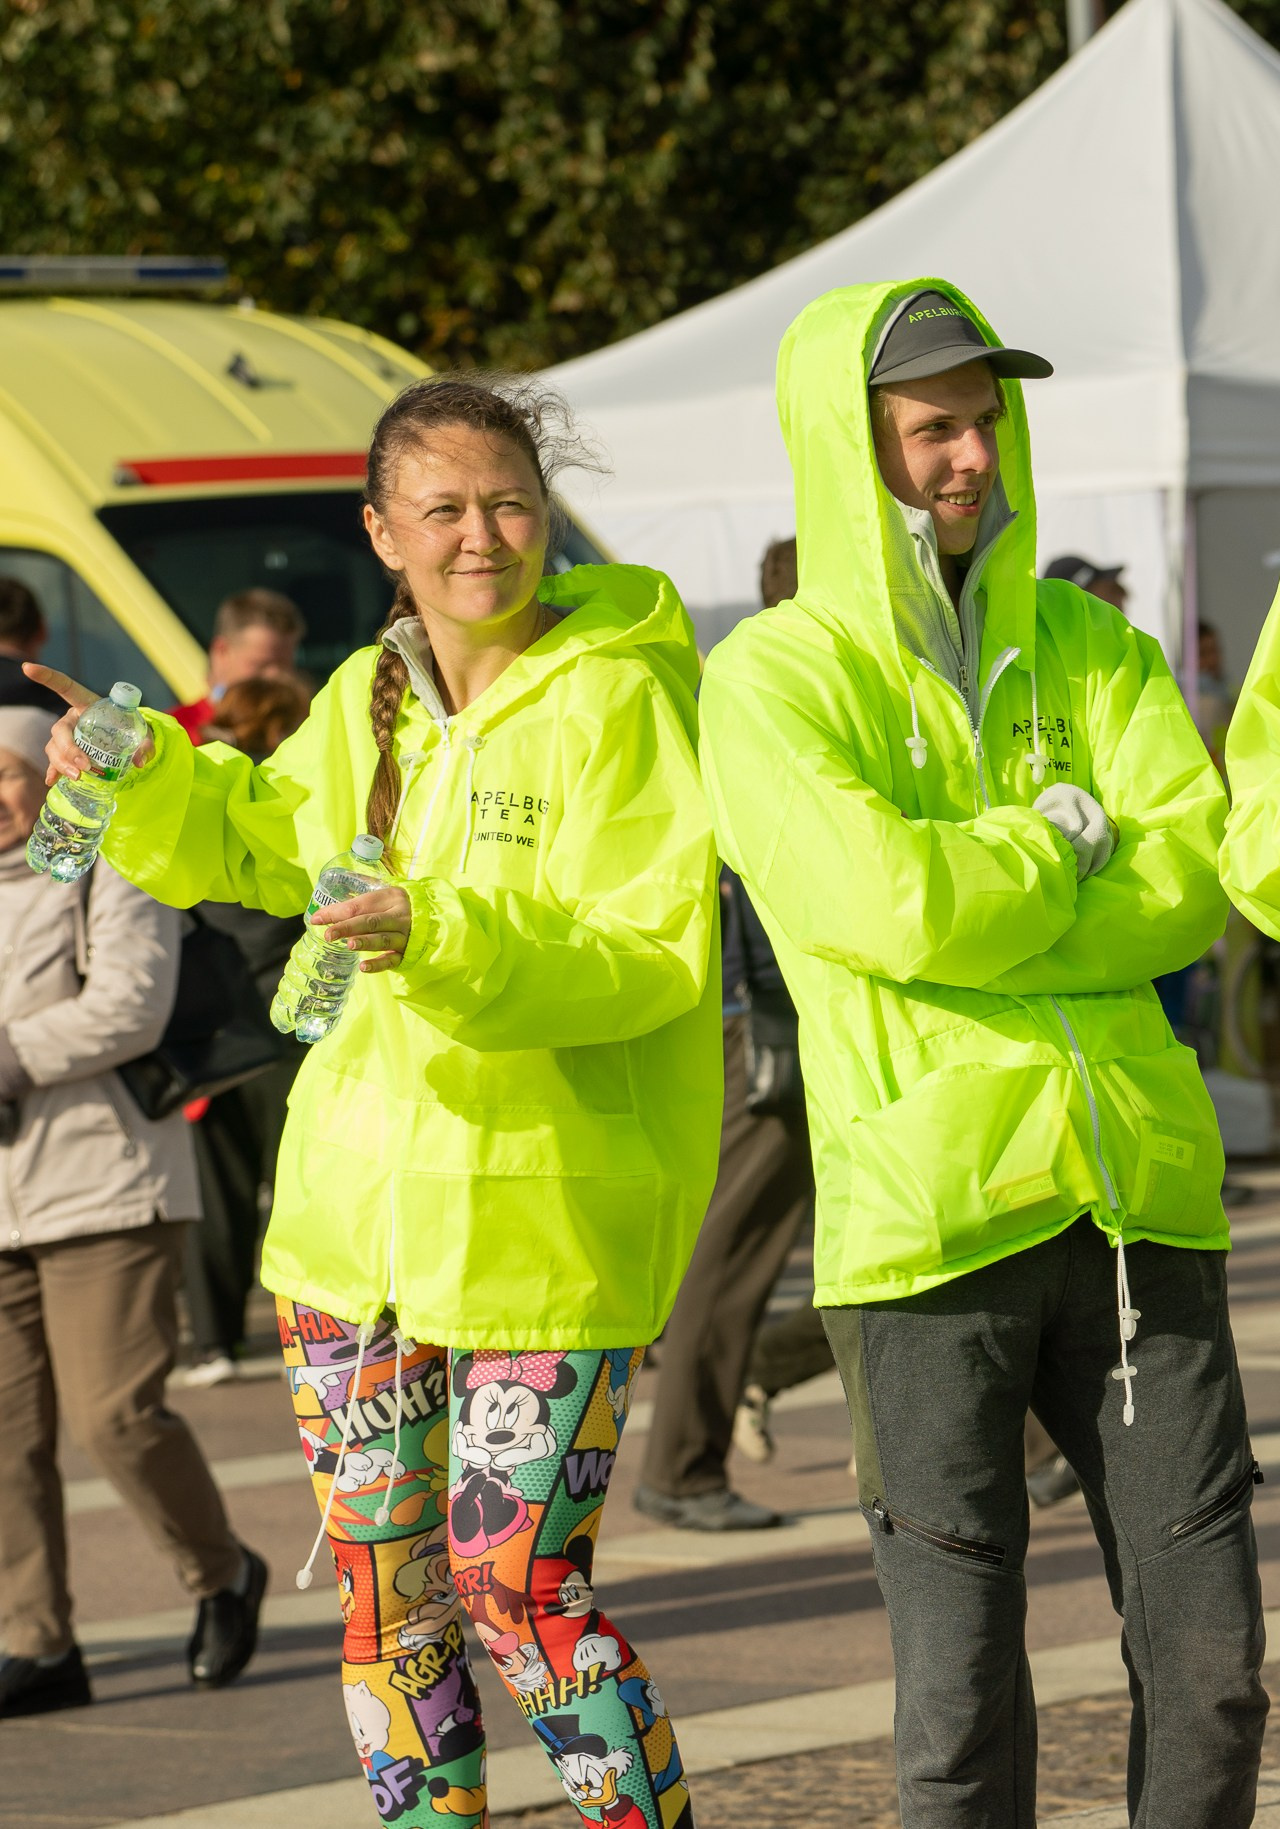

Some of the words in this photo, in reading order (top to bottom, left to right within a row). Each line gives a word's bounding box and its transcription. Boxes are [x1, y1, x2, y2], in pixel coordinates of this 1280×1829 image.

[1026, 733, 1070, 749] TEA
[480, 808, 535, 826] TEA
[474, 832, 513, 843] UNITED
[516, 835, 535, 848] WE
[329, 1370, 447, 1443] HUH?
